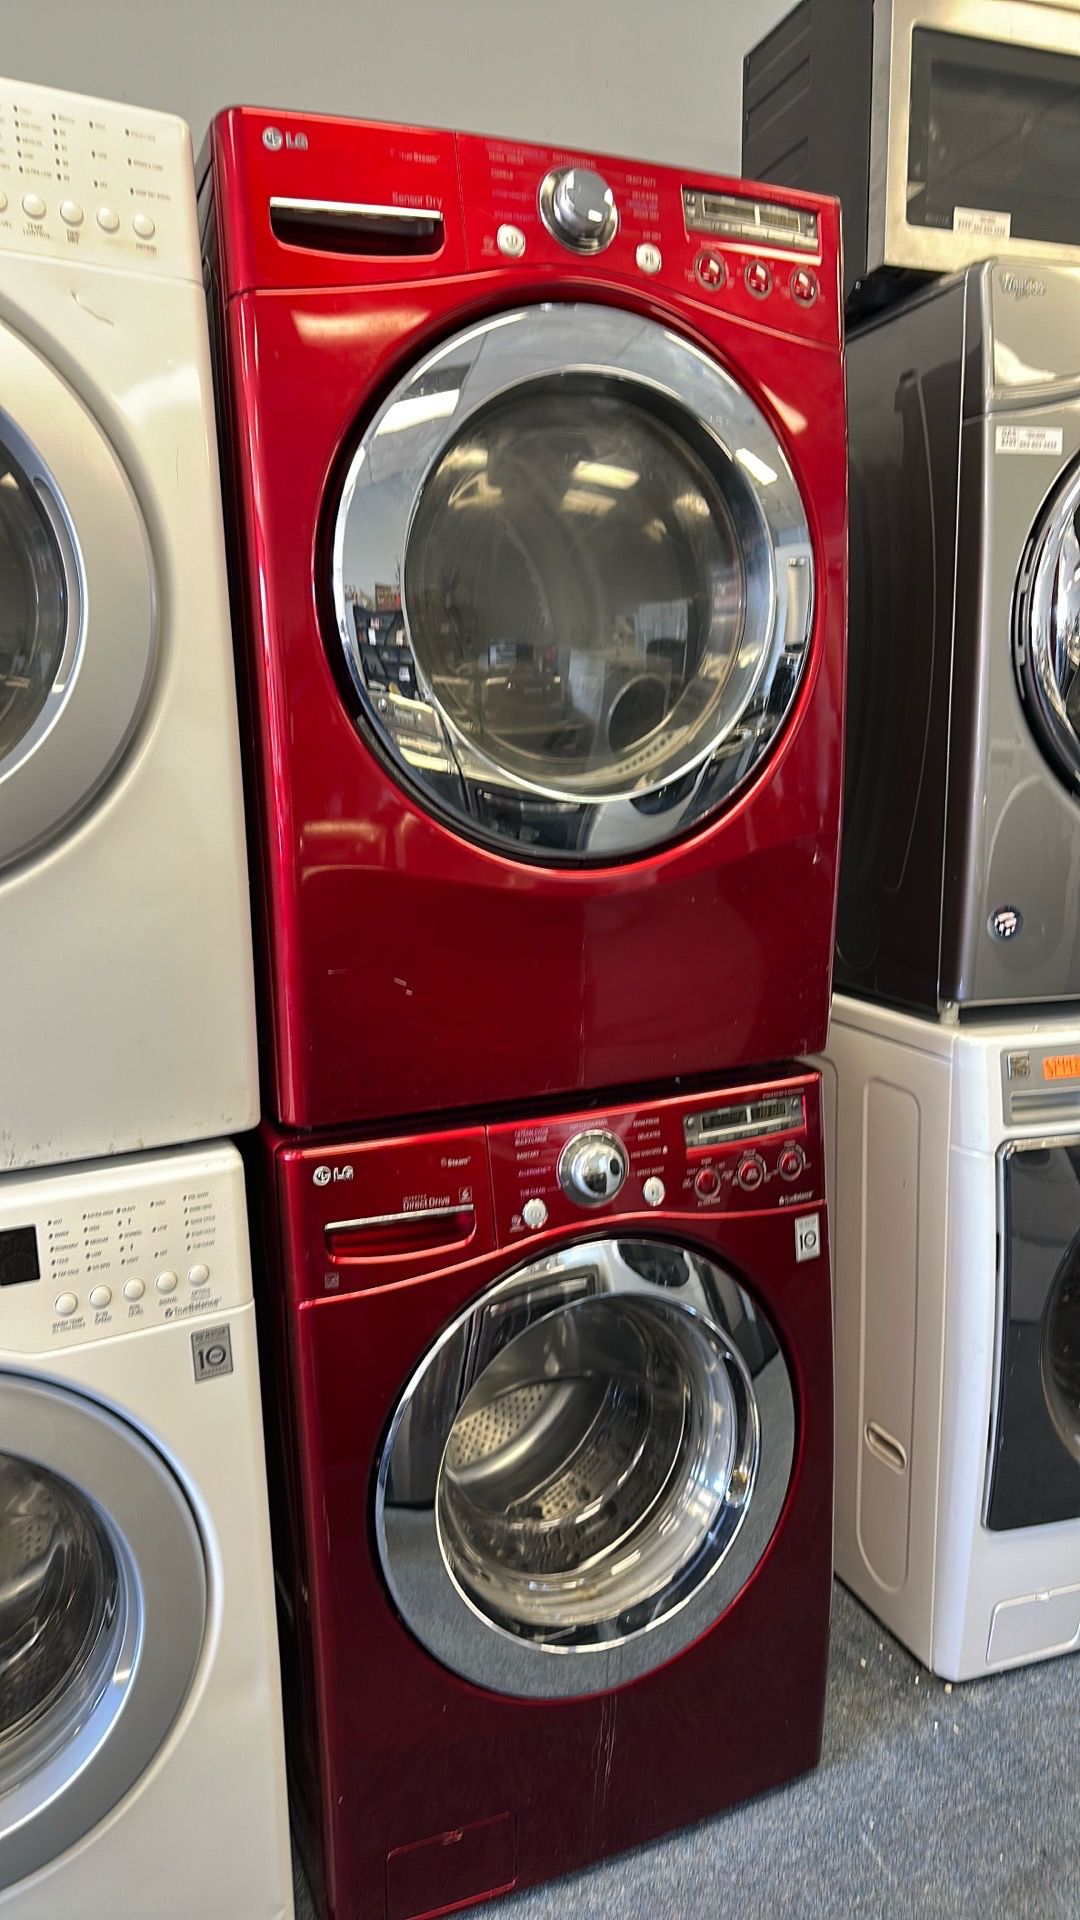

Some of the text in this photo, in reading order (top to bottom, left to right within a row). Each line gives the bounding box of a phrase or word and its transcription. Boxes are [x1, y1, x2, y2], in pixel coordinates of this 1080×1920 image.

[392, 191, 443, 209] Sensor Dry
[429, 1196, 450, 1208] Drive
[198, 1344, 227, 1370] 10
